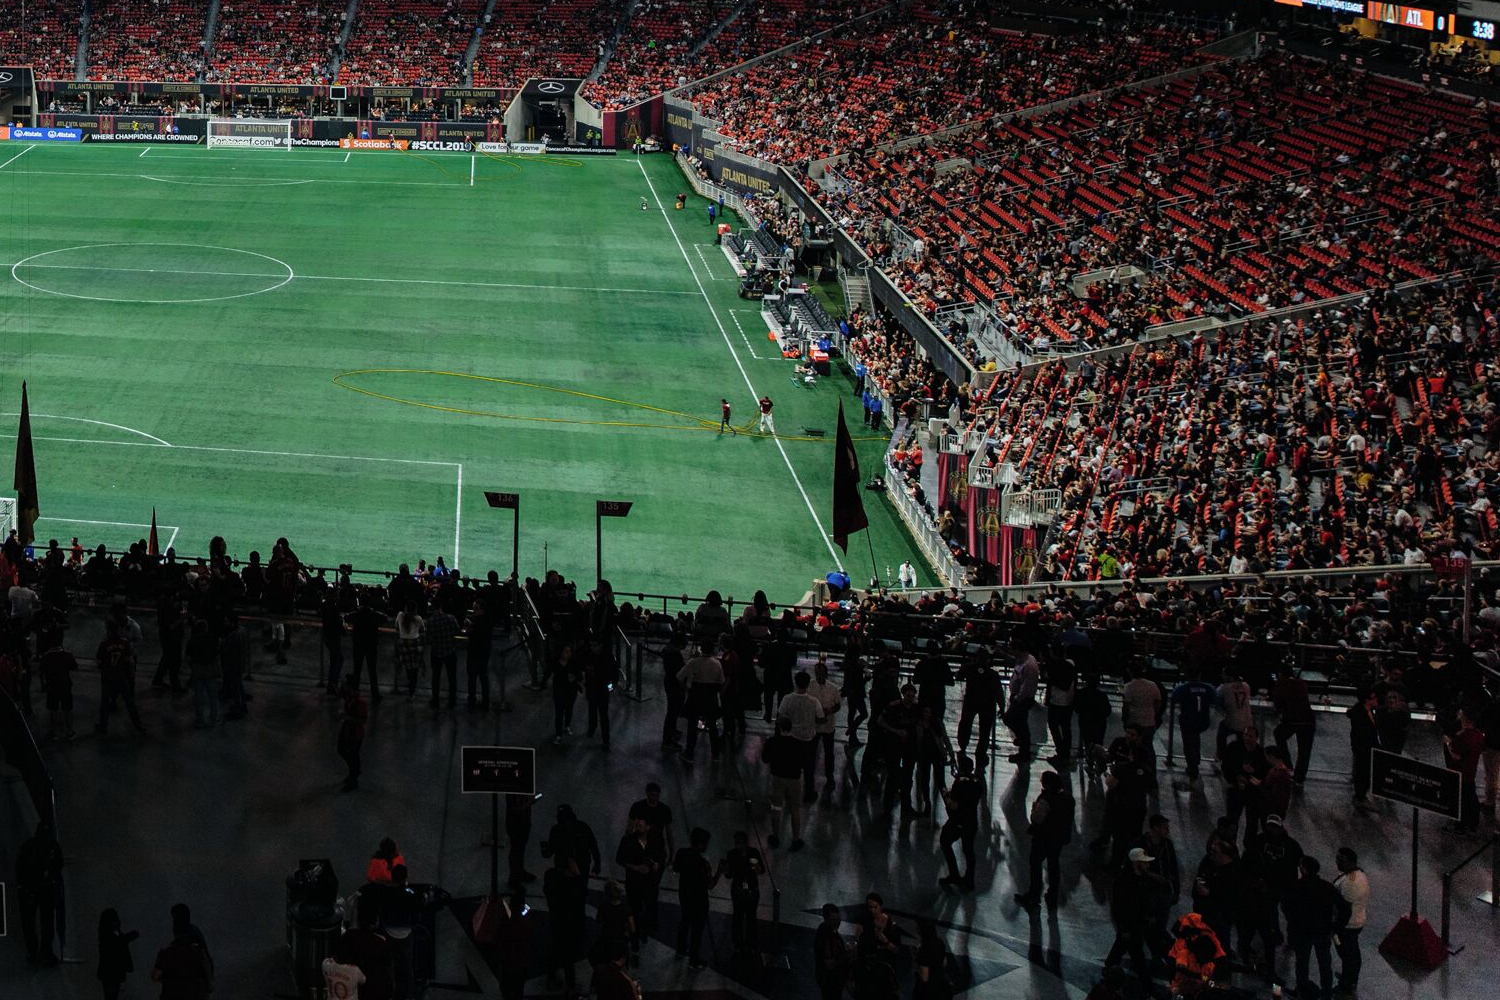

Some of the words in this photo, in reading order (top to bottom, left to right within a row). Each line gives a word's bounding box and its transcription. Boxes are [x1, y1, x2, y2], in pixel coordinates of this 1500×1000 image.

[1344, 1, 1364, 14] LEAGUE
[1405, 8, 1423, 26] ATL
[1437, 15, 1445, 31] 0
[1472, 20, 1494, 40] 3:38
[67, 83, 91, 91] ATLANTA
[92, 83, 115, 91] UNITED
[250, 86, 275, 94] ATLANTA
[276, 86, 299, 94] UNITED
[444, 89, 472, 97] ATLANTA
[473, 90, 496, 98] UNITED
[79, 121, 98, 129] UNITED
[235, 124, 266, 133] ATLANTA
[439, 130, 463, 138] ATLANTA
